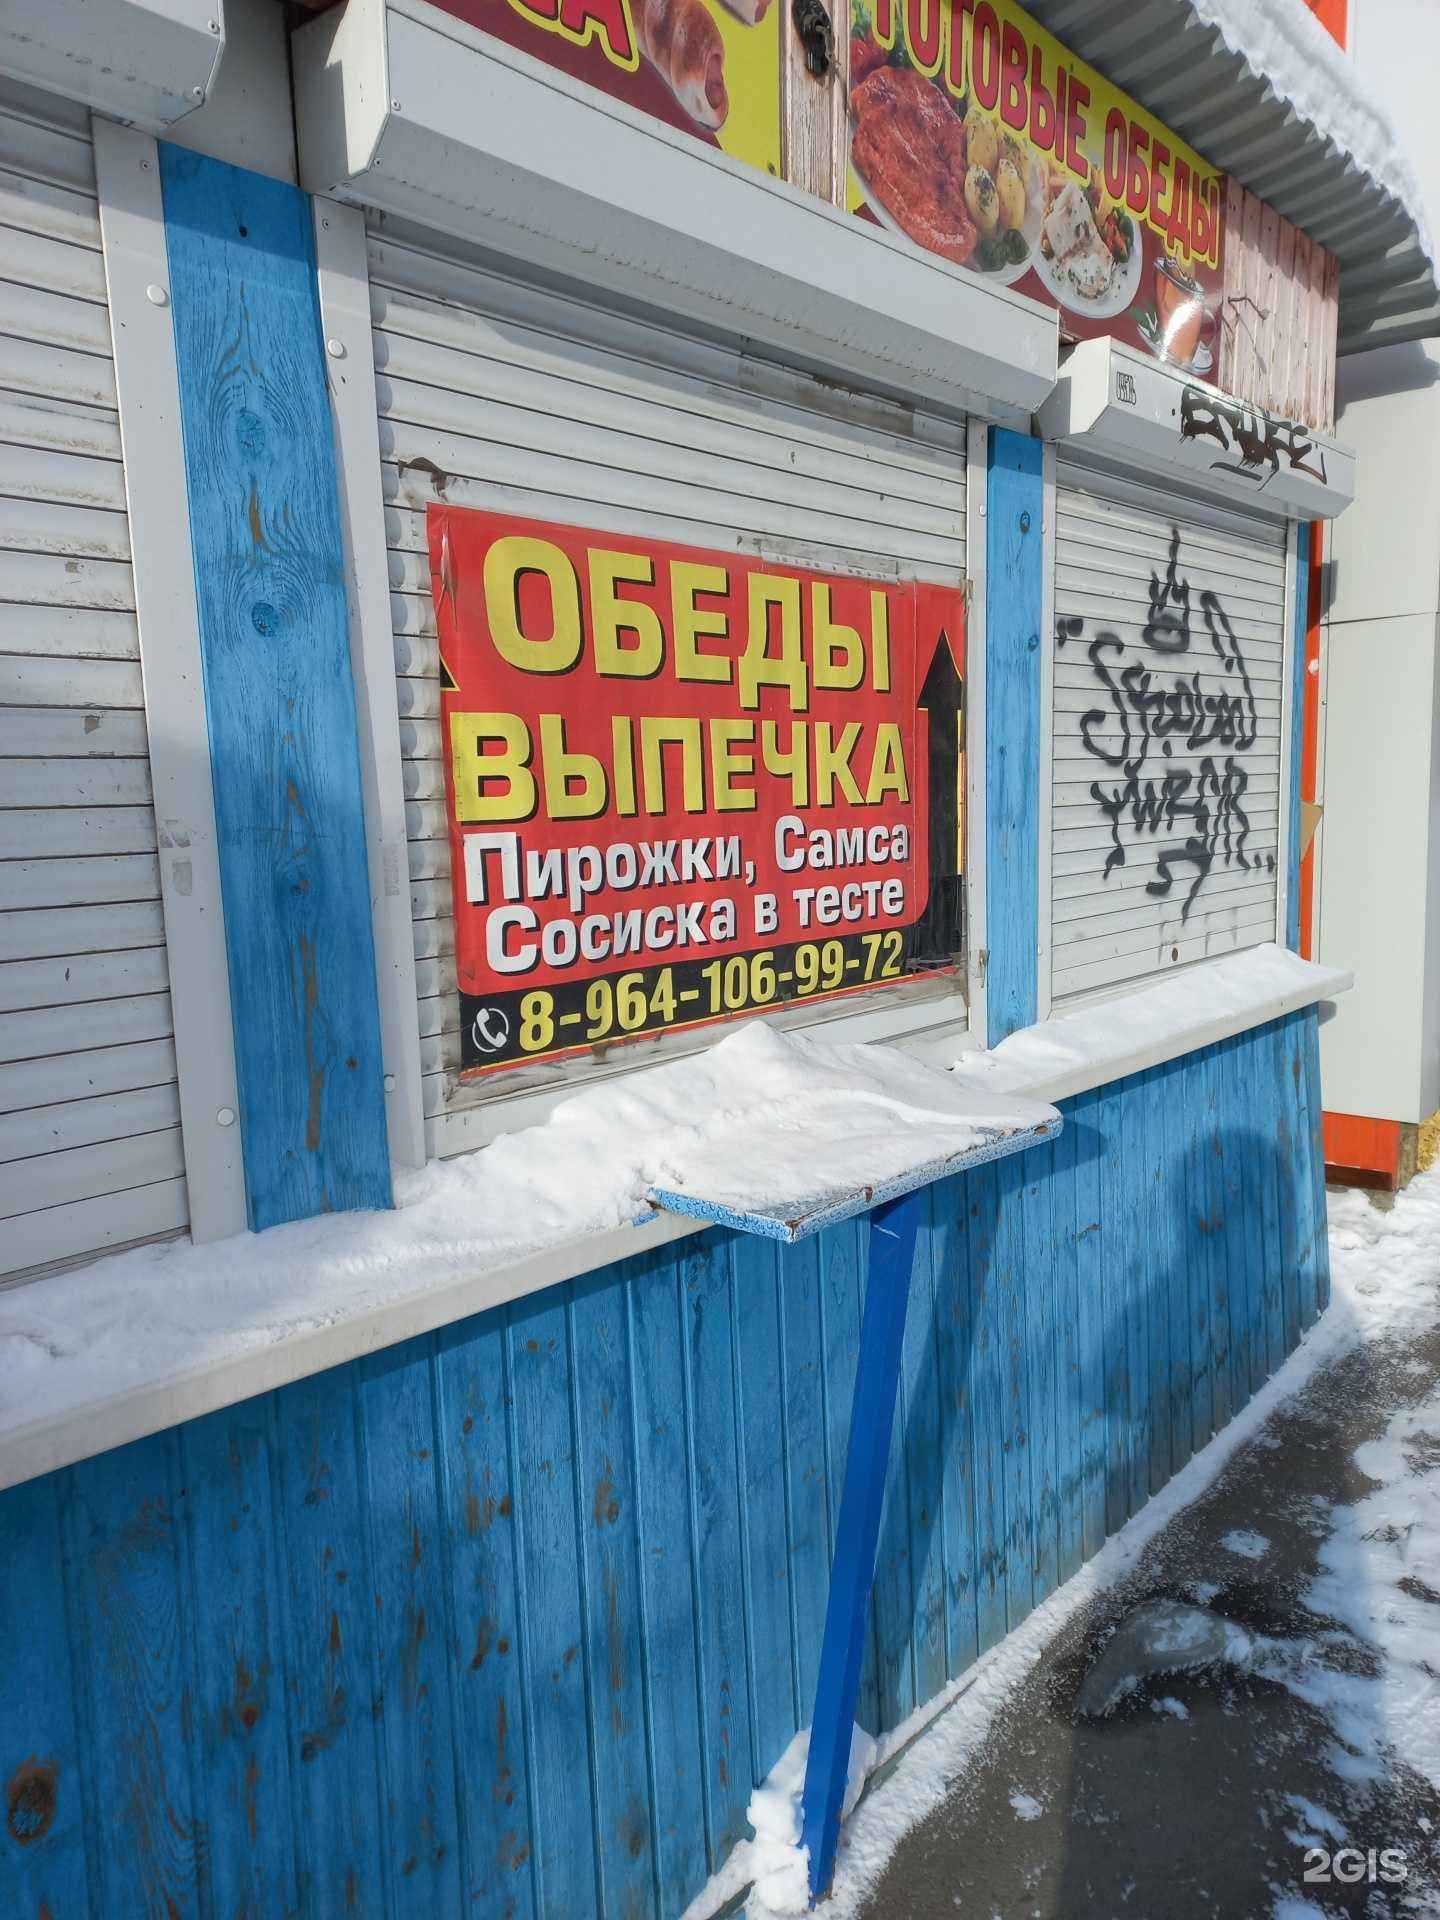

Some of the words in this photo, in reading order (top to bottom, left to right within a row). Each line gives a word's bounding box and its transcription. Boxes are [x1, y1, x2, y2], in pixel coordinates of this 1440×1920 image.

[1103, 106, 1220, 264] ОБЕДЫ
[483, 535, 891, 711] ОБЕДЫ
[449, 710, 911, 823] ВЫПЕЧКА
[463, 831, 756, 913] Пирожки,
[773, 814, 910, 873] Самса
[485, 896, 736, 976] Сосиска
[753, 891, 778, 935] в
[792, 876, 905, 929] тесте
[519, 931, 904, 1052] 8-964-106-99-72
